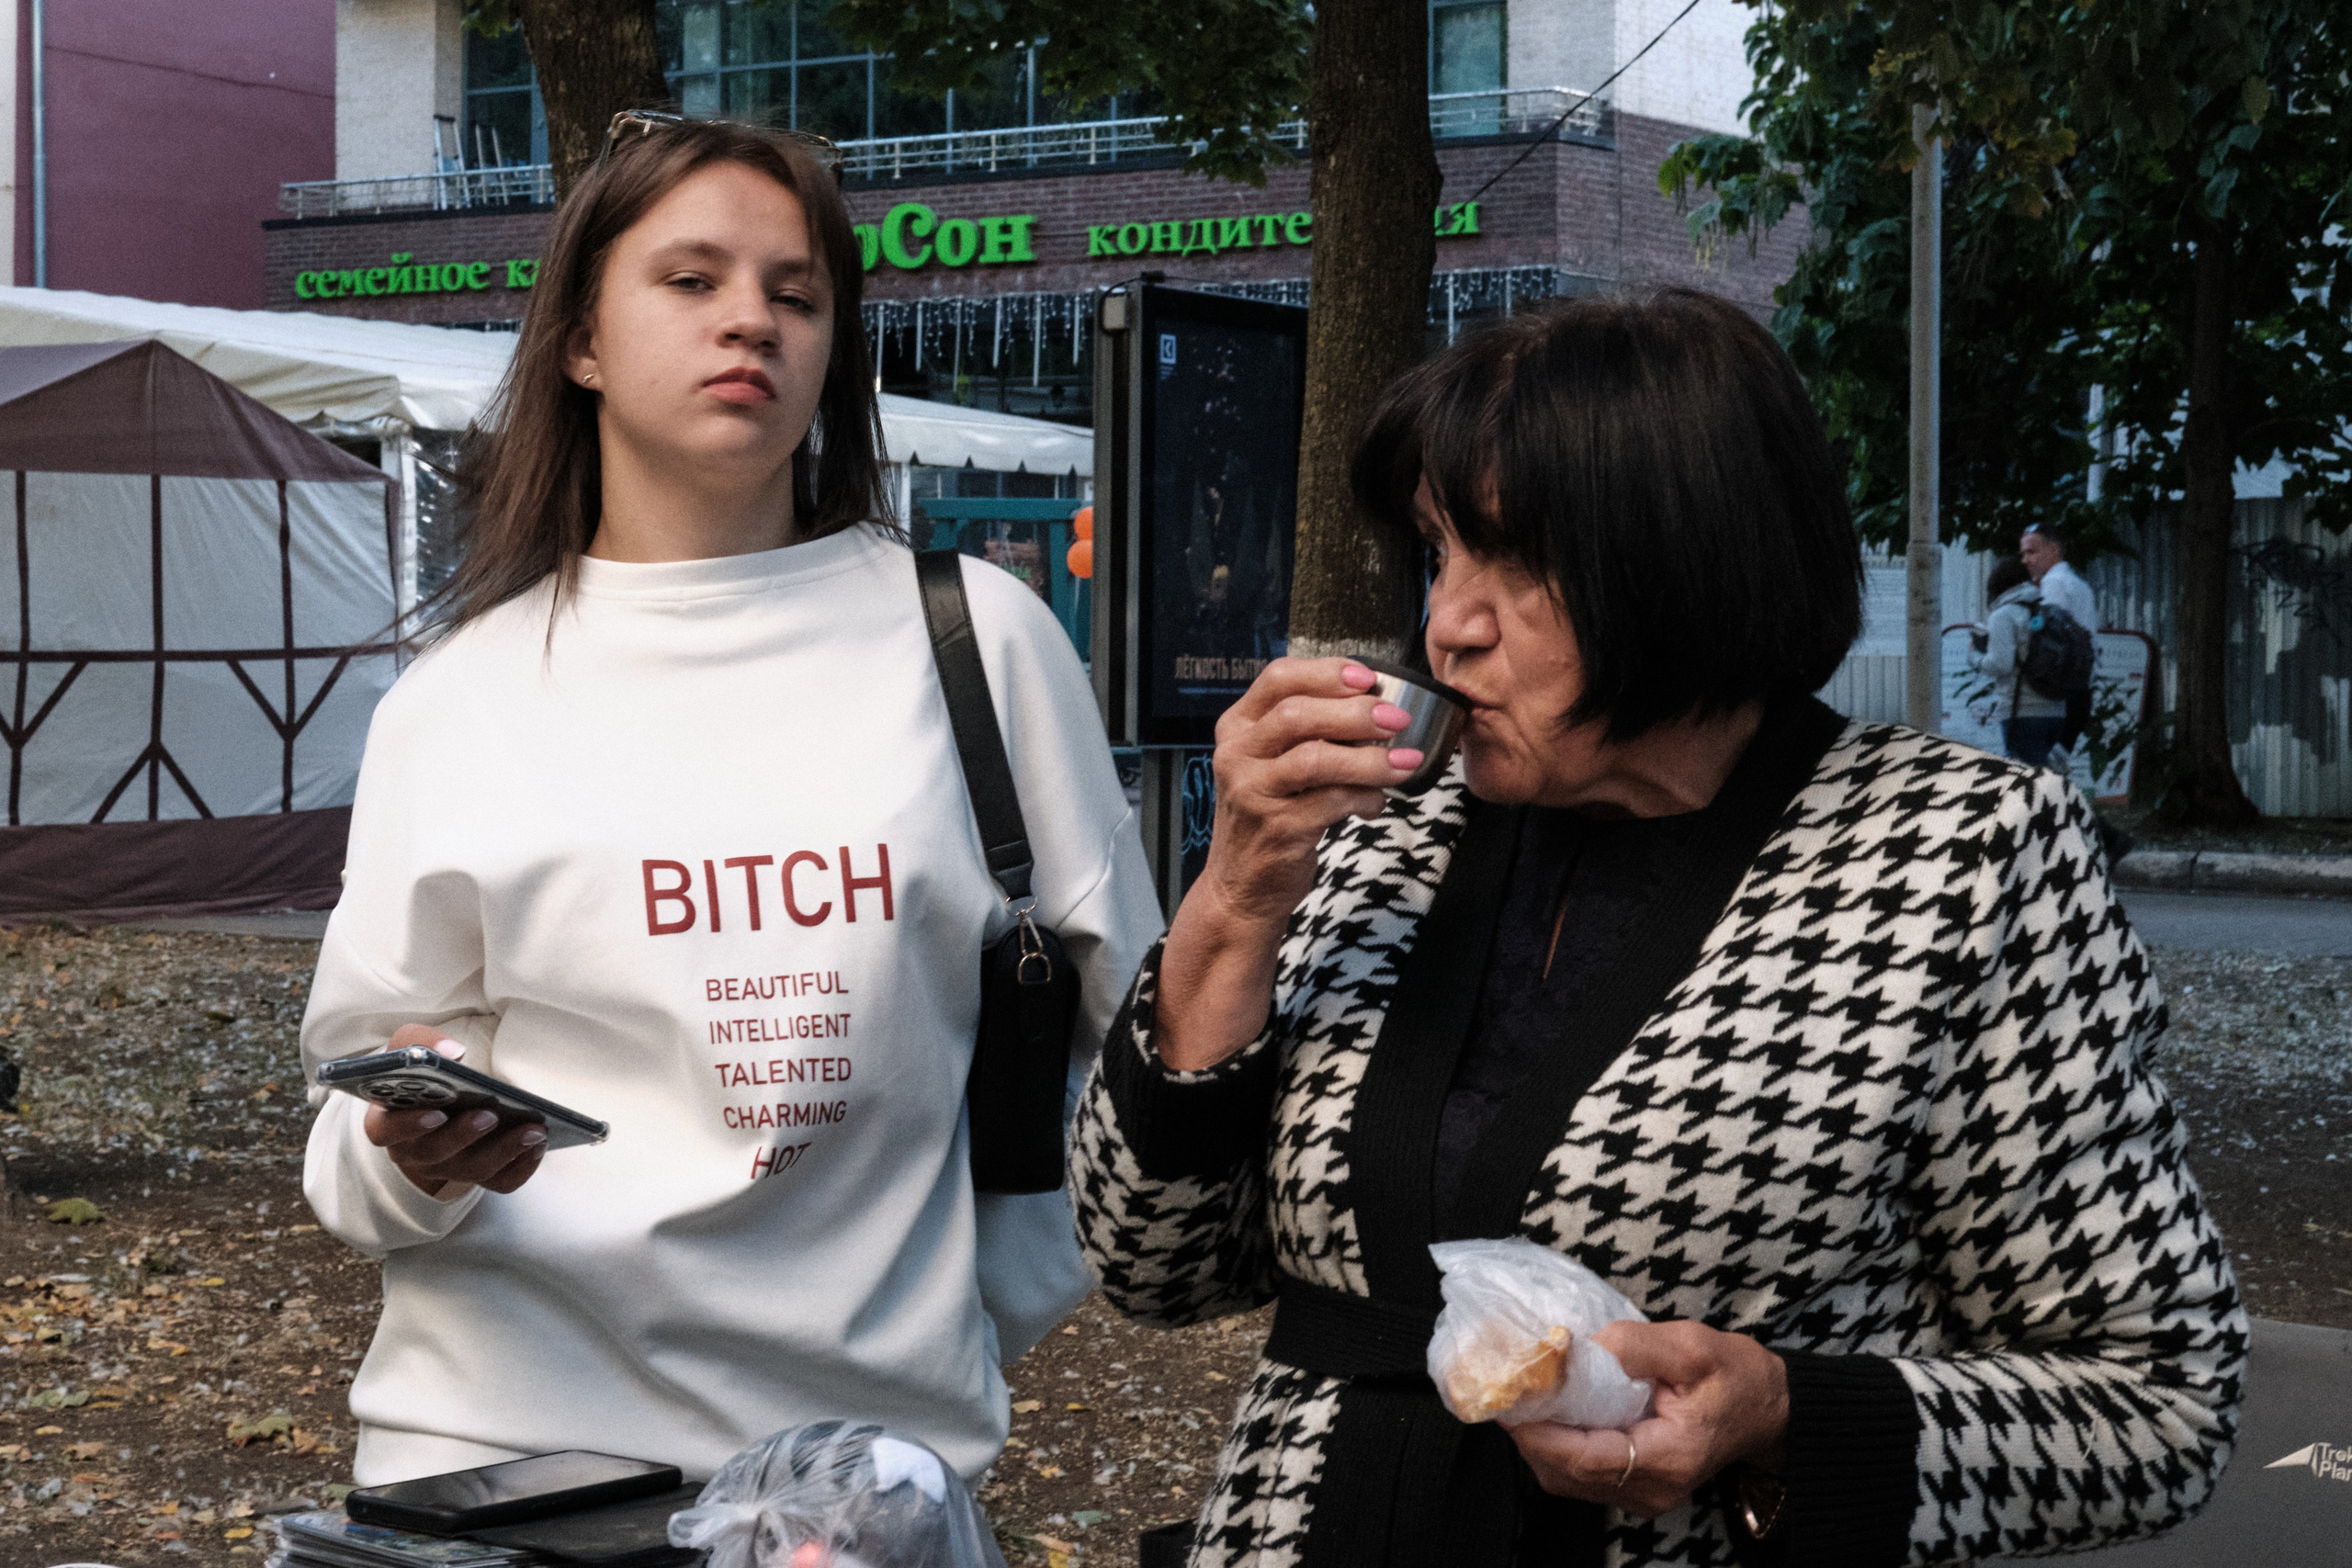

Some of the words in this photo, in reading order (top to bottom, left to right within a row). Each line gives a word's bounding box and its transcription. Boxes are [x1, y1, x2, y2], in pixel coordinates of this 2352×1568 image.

[295, 253, 491, 299] семейное
[641, 843, 895, 936] BITCH
[706, 970, 850, 1001] BEAUTIFUL
[709, 1013, 852, 1044] INTELLIGENT
[715, 1057, 852, 1088] TALENTED
[723, 1100, 847, 1129] CHARMING
[751, 1141, 813, 1180] HOT
